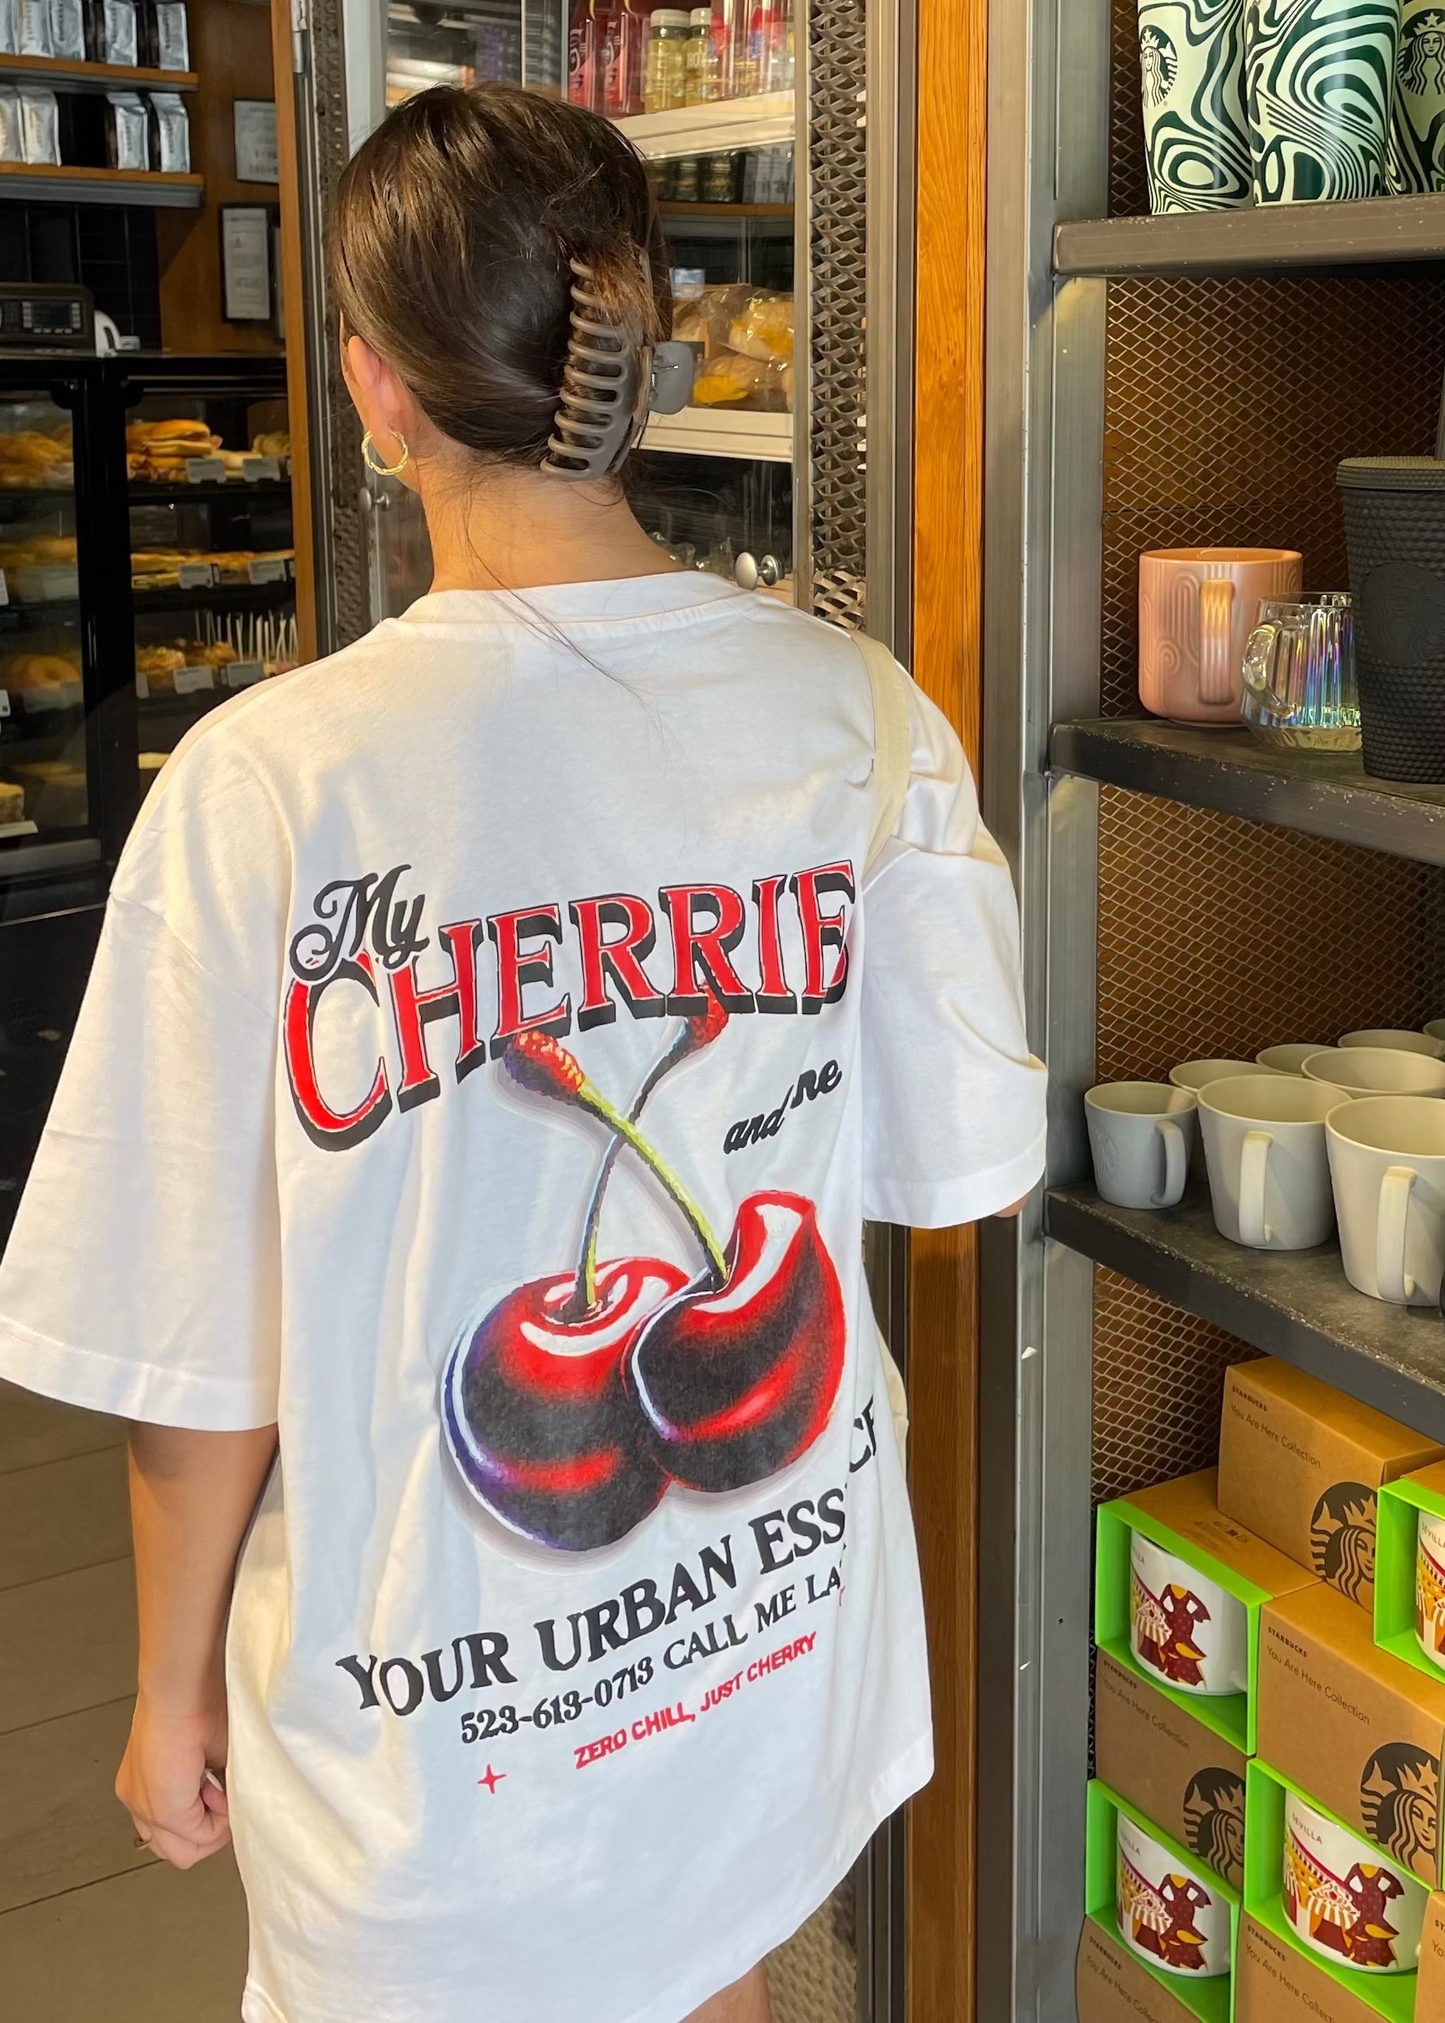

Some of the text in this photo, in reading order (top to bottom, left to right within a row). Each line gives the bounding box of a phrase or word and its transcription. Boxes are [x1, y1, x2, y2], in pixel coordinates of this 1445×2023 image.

[290, 864, 430, 981] My
[284, 858, 857, 1152] CHERRIE
[723, 1084, 794, 1154] and
[1232, 1385, 1267, 1411] STARBUCKS
[1231, 1403, 1321, 1468] You Are Here Collection
[335, 1631, 518, 1716] YOUR
[533, 1533, 737, 1672] URBAN
[1267, 1626, 1308, 1658] STARBUCKS
[461, 1656, 654, 1743] 523-613-0713
[663, 1614, 748, 1670] CALL
[754, 1584, 797, 1633] ME
[1267, 1645, 1370, 1725] You Are Here Collection
[574, 1631, 817, 1770] ZERO CHILL, JUST CHERRY
[1102, 1677, 1190, 1750] You Are Here Collection
[1292, 1812, 1323, 1845] SEVILLA
[1246, 1942, 1260, 1963] You
[1262, 1959, 1277, 1978] Are
[1279, 1971, 1300, 1998] Here
[1247, 1924, 1286, 1962] STARBUCKS
[1432, 1939, 1445, 1959] Yo
